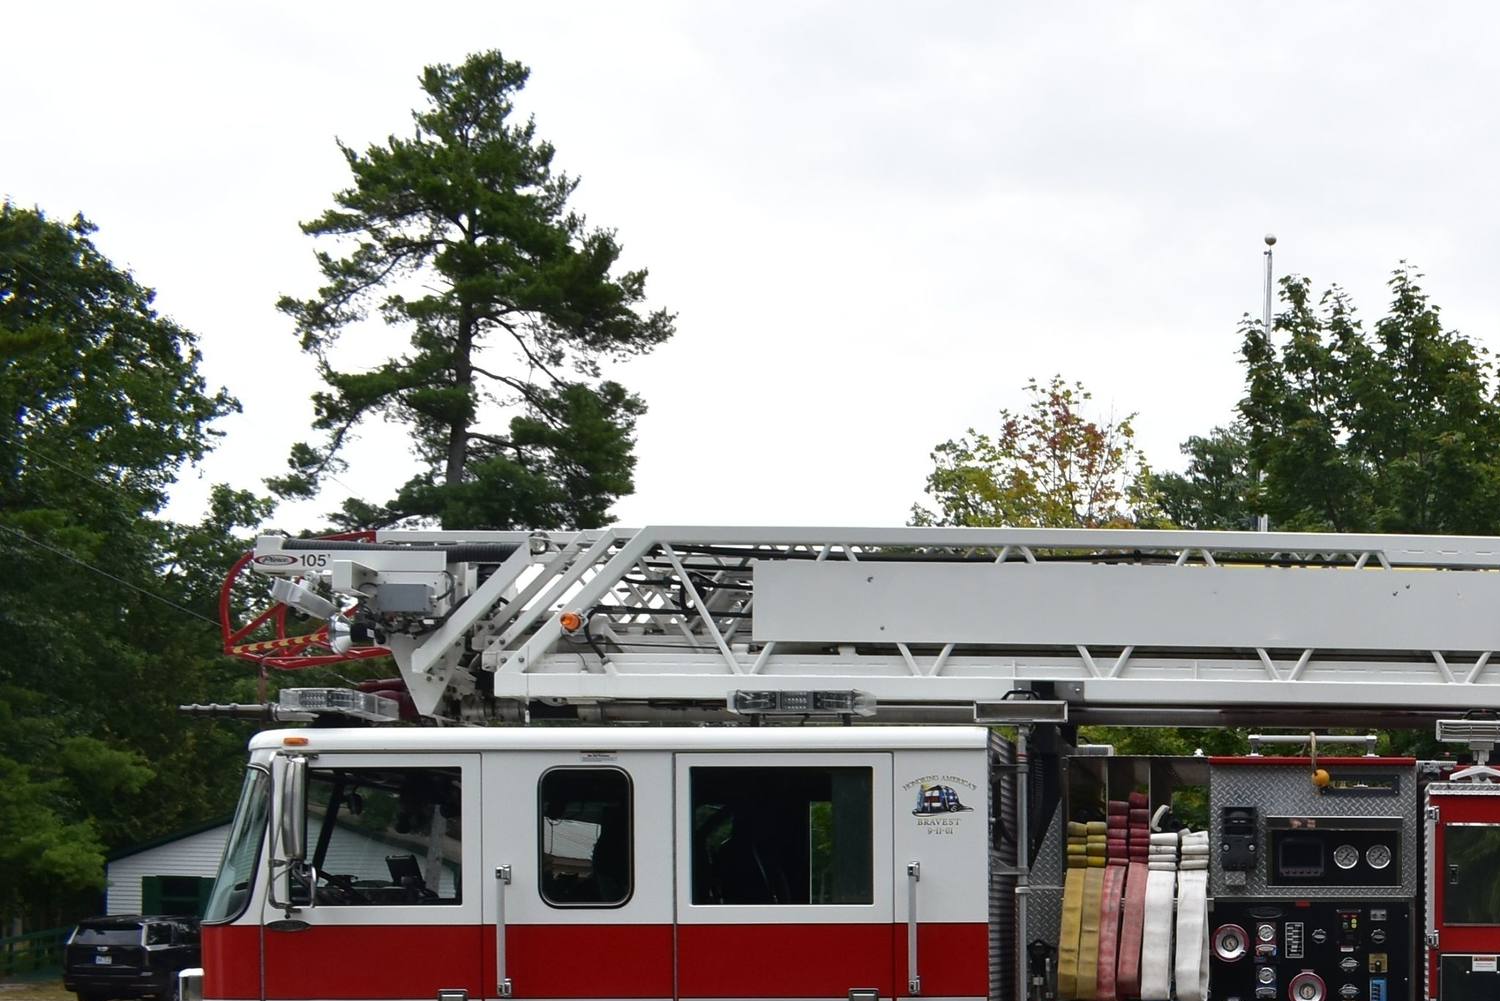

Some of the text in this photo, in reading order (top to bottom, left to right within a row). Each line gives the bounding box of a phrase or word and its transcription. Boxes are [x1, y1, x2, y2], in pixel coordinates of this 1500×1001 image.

[299, 554, 331, 567] 105'
[902, 774, 940, 791] HONORING
[917, 818, 962, 826] BRAVEST
[927, 827, 954, 835] 9-11-01
